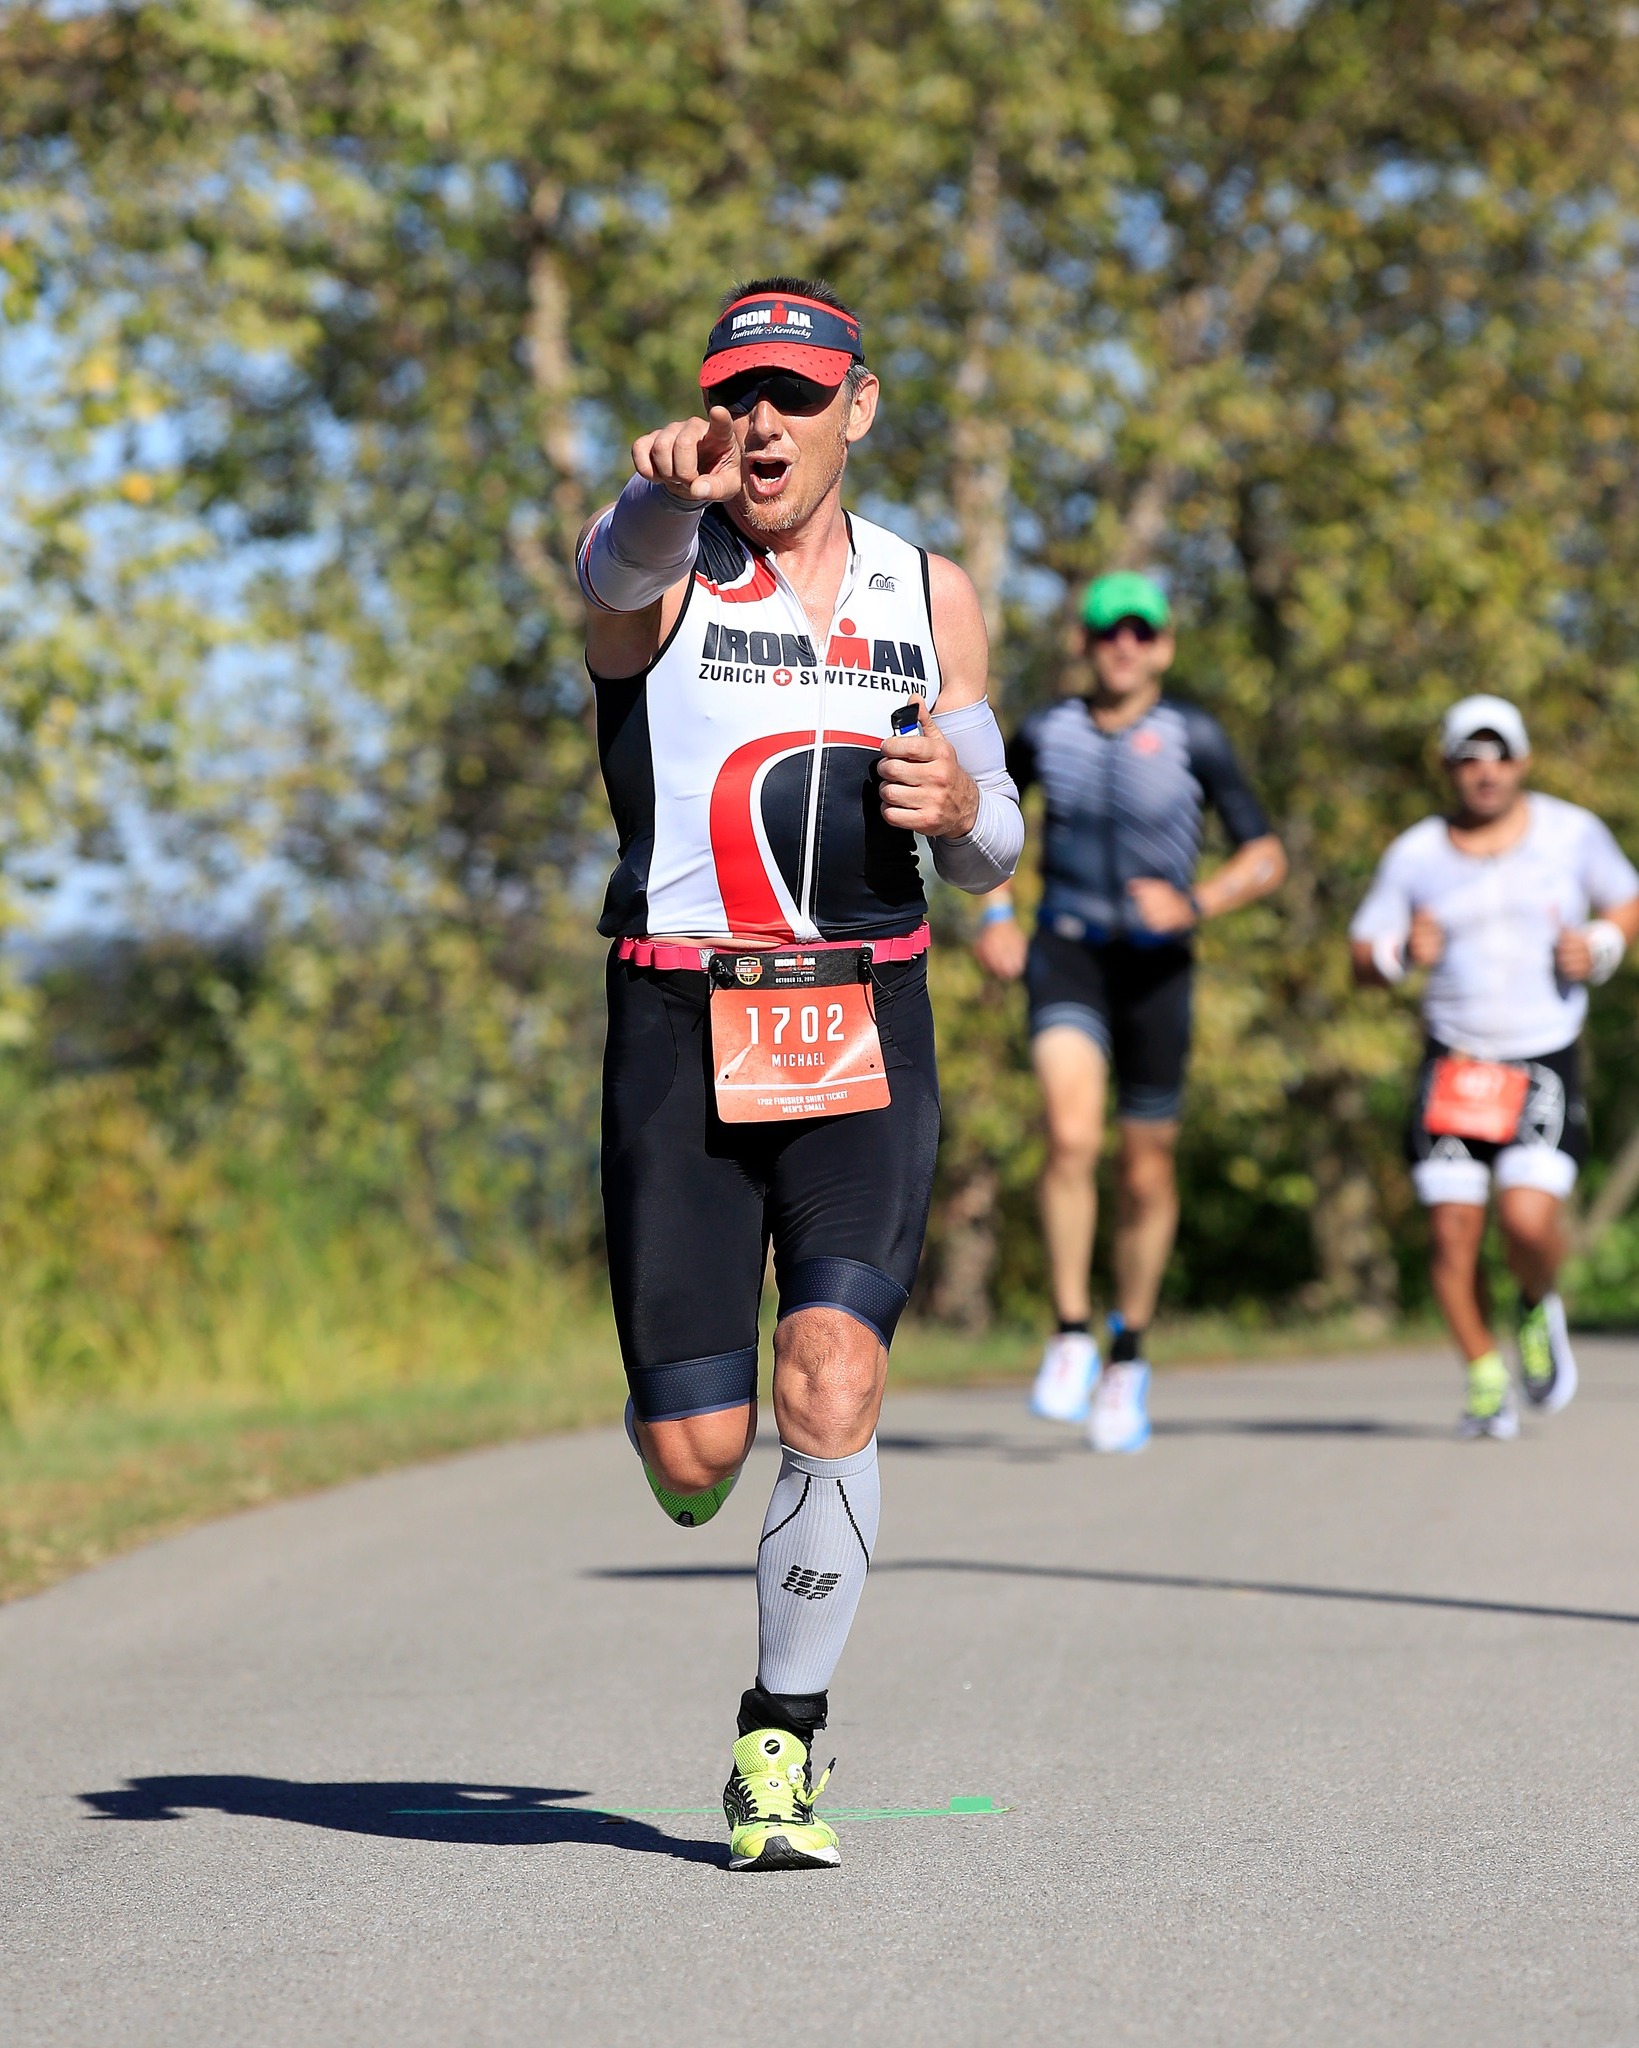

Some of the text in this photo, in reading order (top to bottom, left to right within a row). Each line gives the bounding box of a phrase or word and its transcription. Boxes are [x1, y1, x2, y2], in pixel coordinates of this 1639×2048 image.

[732, 301, 811, 330] IRONMAN
[730, 325, 811, 340] Louisville Kentucky
[702, 618, 926, 681] IRONMAN
[698, 663, 927, 699] ZURICH SWITZERLAND
[745, 1003, 845, 1045] 1702
[771, 1052, 826, 1068] MICHAEL
[757, 1090, 848, 1106] 1702 FINISHER SHIRT TICKET
[782, 1103, 826, 1114] MEN'S SMALL
